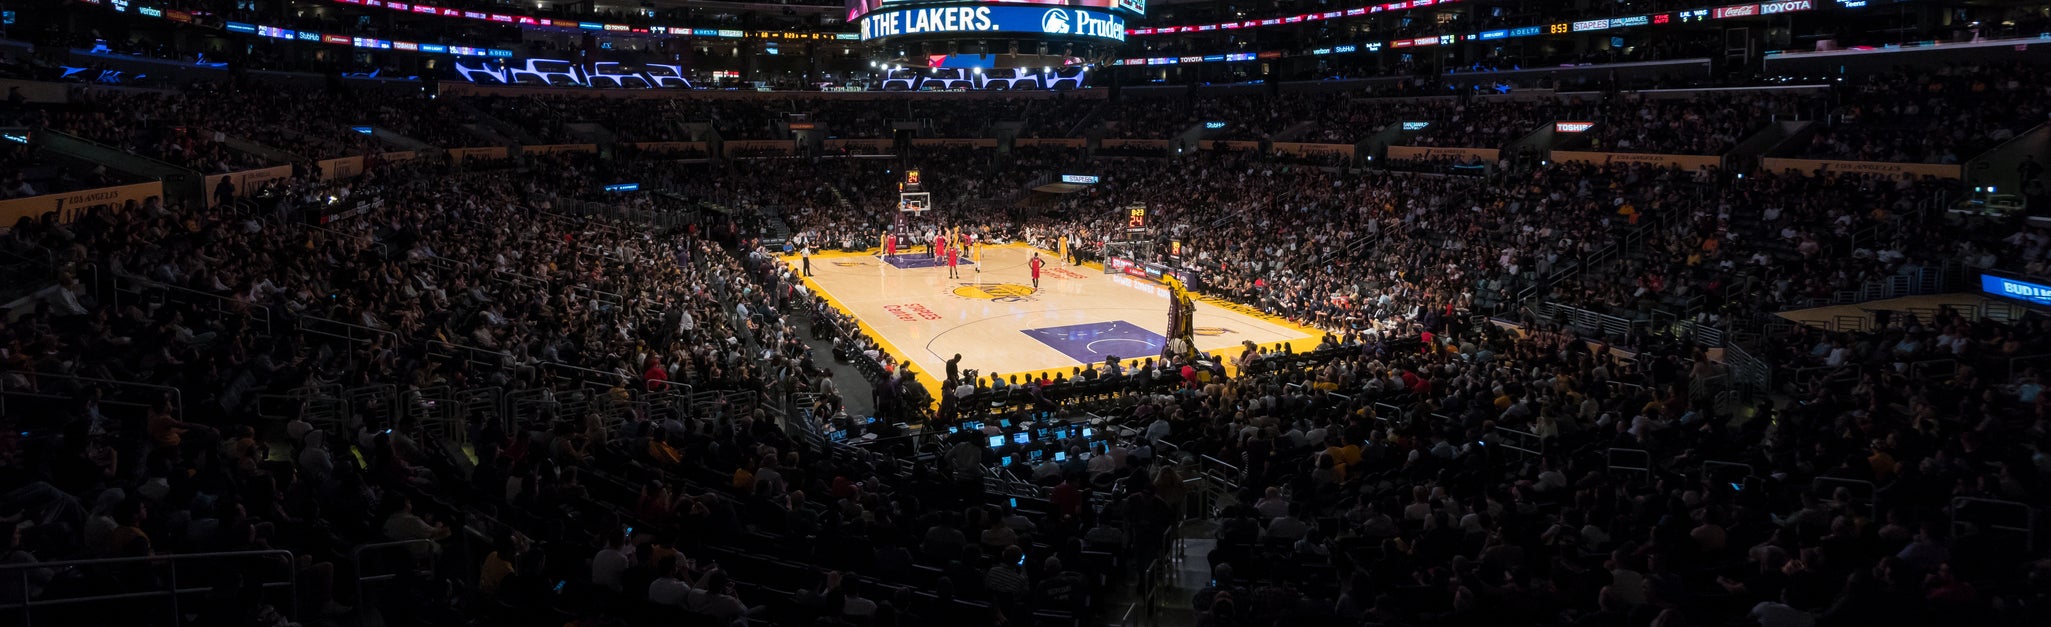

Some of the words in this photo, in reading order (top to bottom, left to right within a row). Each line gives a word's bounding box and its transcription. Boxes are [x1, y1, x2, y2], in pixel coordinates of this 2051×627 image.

[139, 7, 161, 17] verizon
[1761, 1, 1811, 13] TOYOTA
[873, 11, 899, 37] THE
[906, 6, 999, 32] LAKERS.
[1574, 20, 1608, 31] STAPLES
[1516, 25, 1539, 35] DELTA
[299, 31, 319, 41] StubHub
[1414, 37, 1439, 46] TOSHIBA
[393, 41, 418, 50] TOSHIBA
[69, 195, 83, 204] LOS
[86, 190, 118, 201] ANGELES
[1130, 216, 1143, 227] 24
[2003, 282, 2033, 296] BUD
